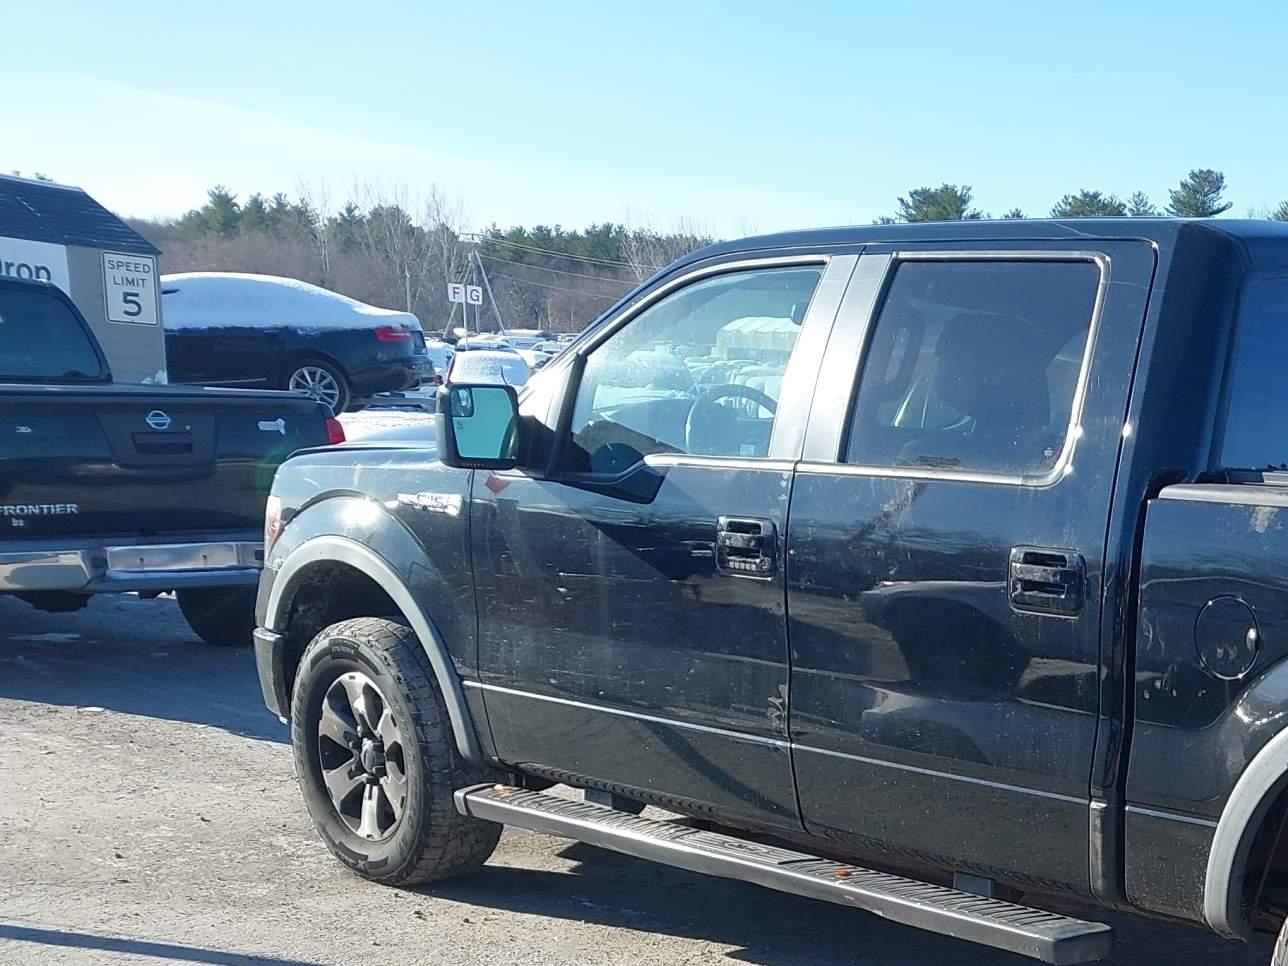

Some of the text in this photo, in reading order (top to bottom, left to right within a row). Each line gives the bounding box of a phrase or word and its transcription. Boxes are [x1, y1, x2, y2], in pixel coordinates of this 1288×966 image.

[0, 258, 51, 281] rop
[107, 259, 150, 273] SPEED
[112, 275, 147, 288] LIMIT
[452, 286, 461, 299] F
[469, 288, 480, 302] G
[122, 291, 142, 317] 5
